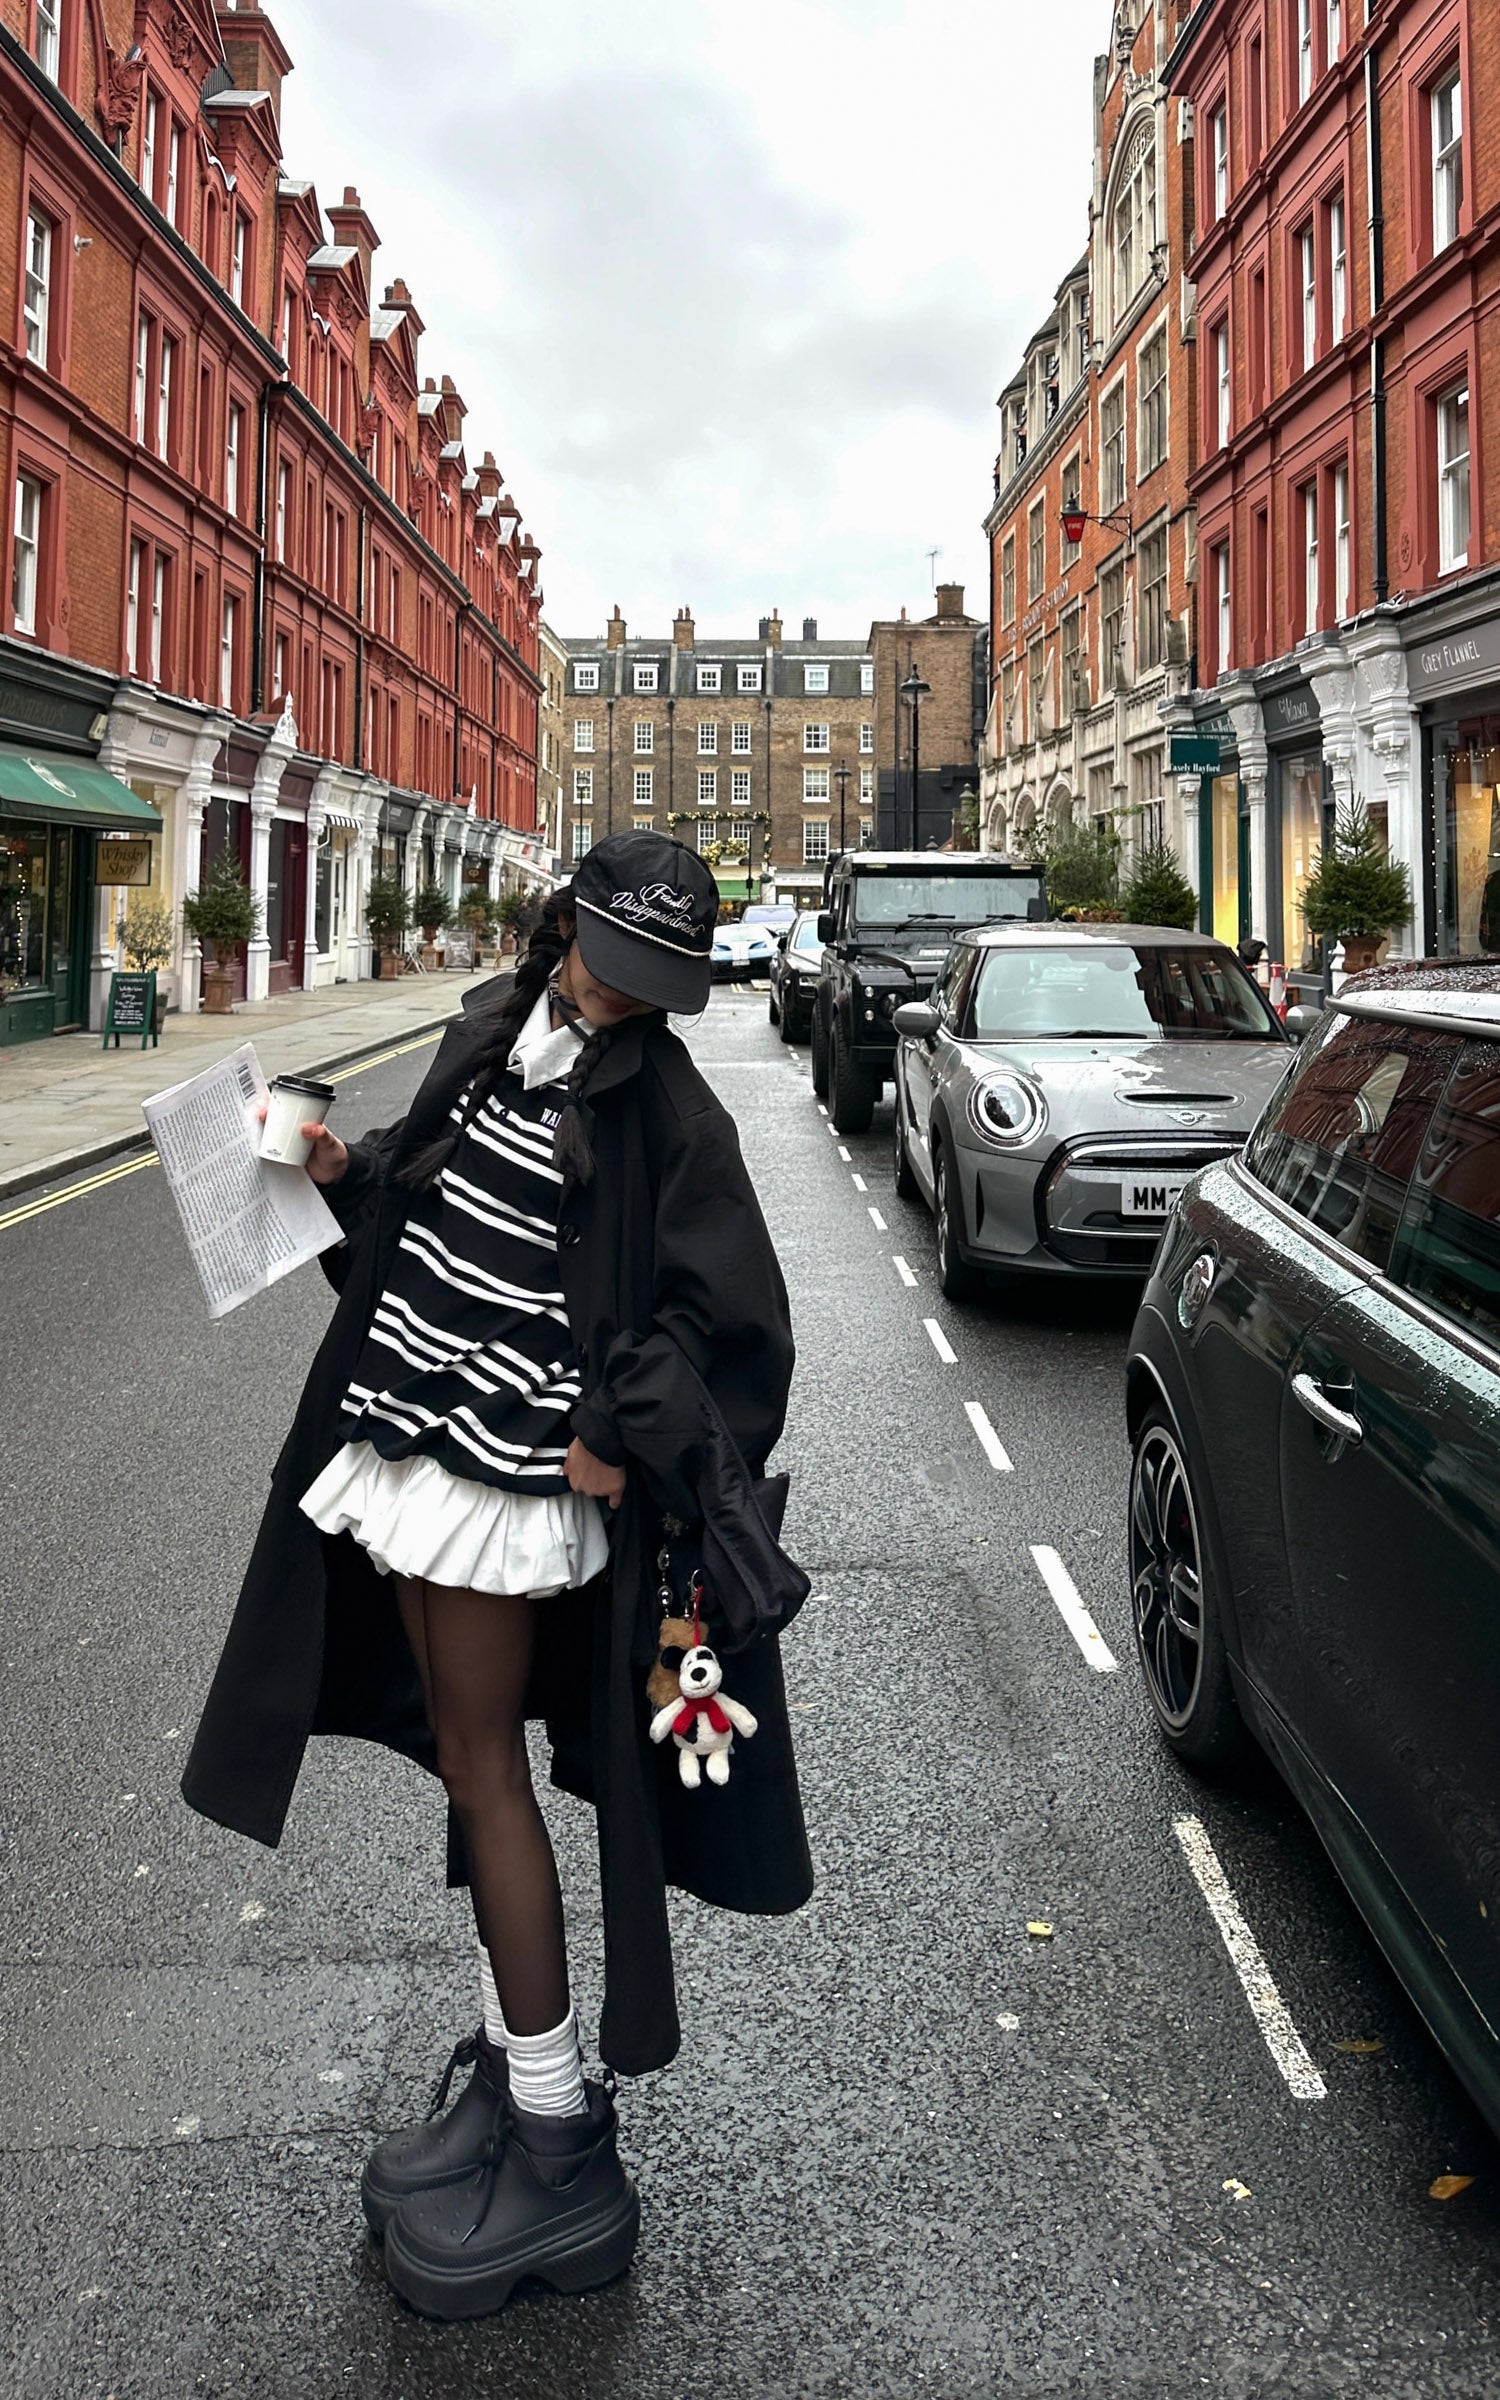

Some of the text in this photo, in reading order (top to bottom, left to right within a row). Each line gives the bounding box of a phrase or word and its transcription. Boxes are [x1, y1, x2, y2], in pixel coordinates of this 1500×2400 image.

[1421, 640, 1480, 674] GREY FLANNEL
[1171, 763, 1220, 775] asely Hayford
[102, 847, 148, 865] Whisky
[105, 861, 138, 880] Shop
[639, 883, 695, 916] Family
[609, 891, 706, 938] Disappointment
